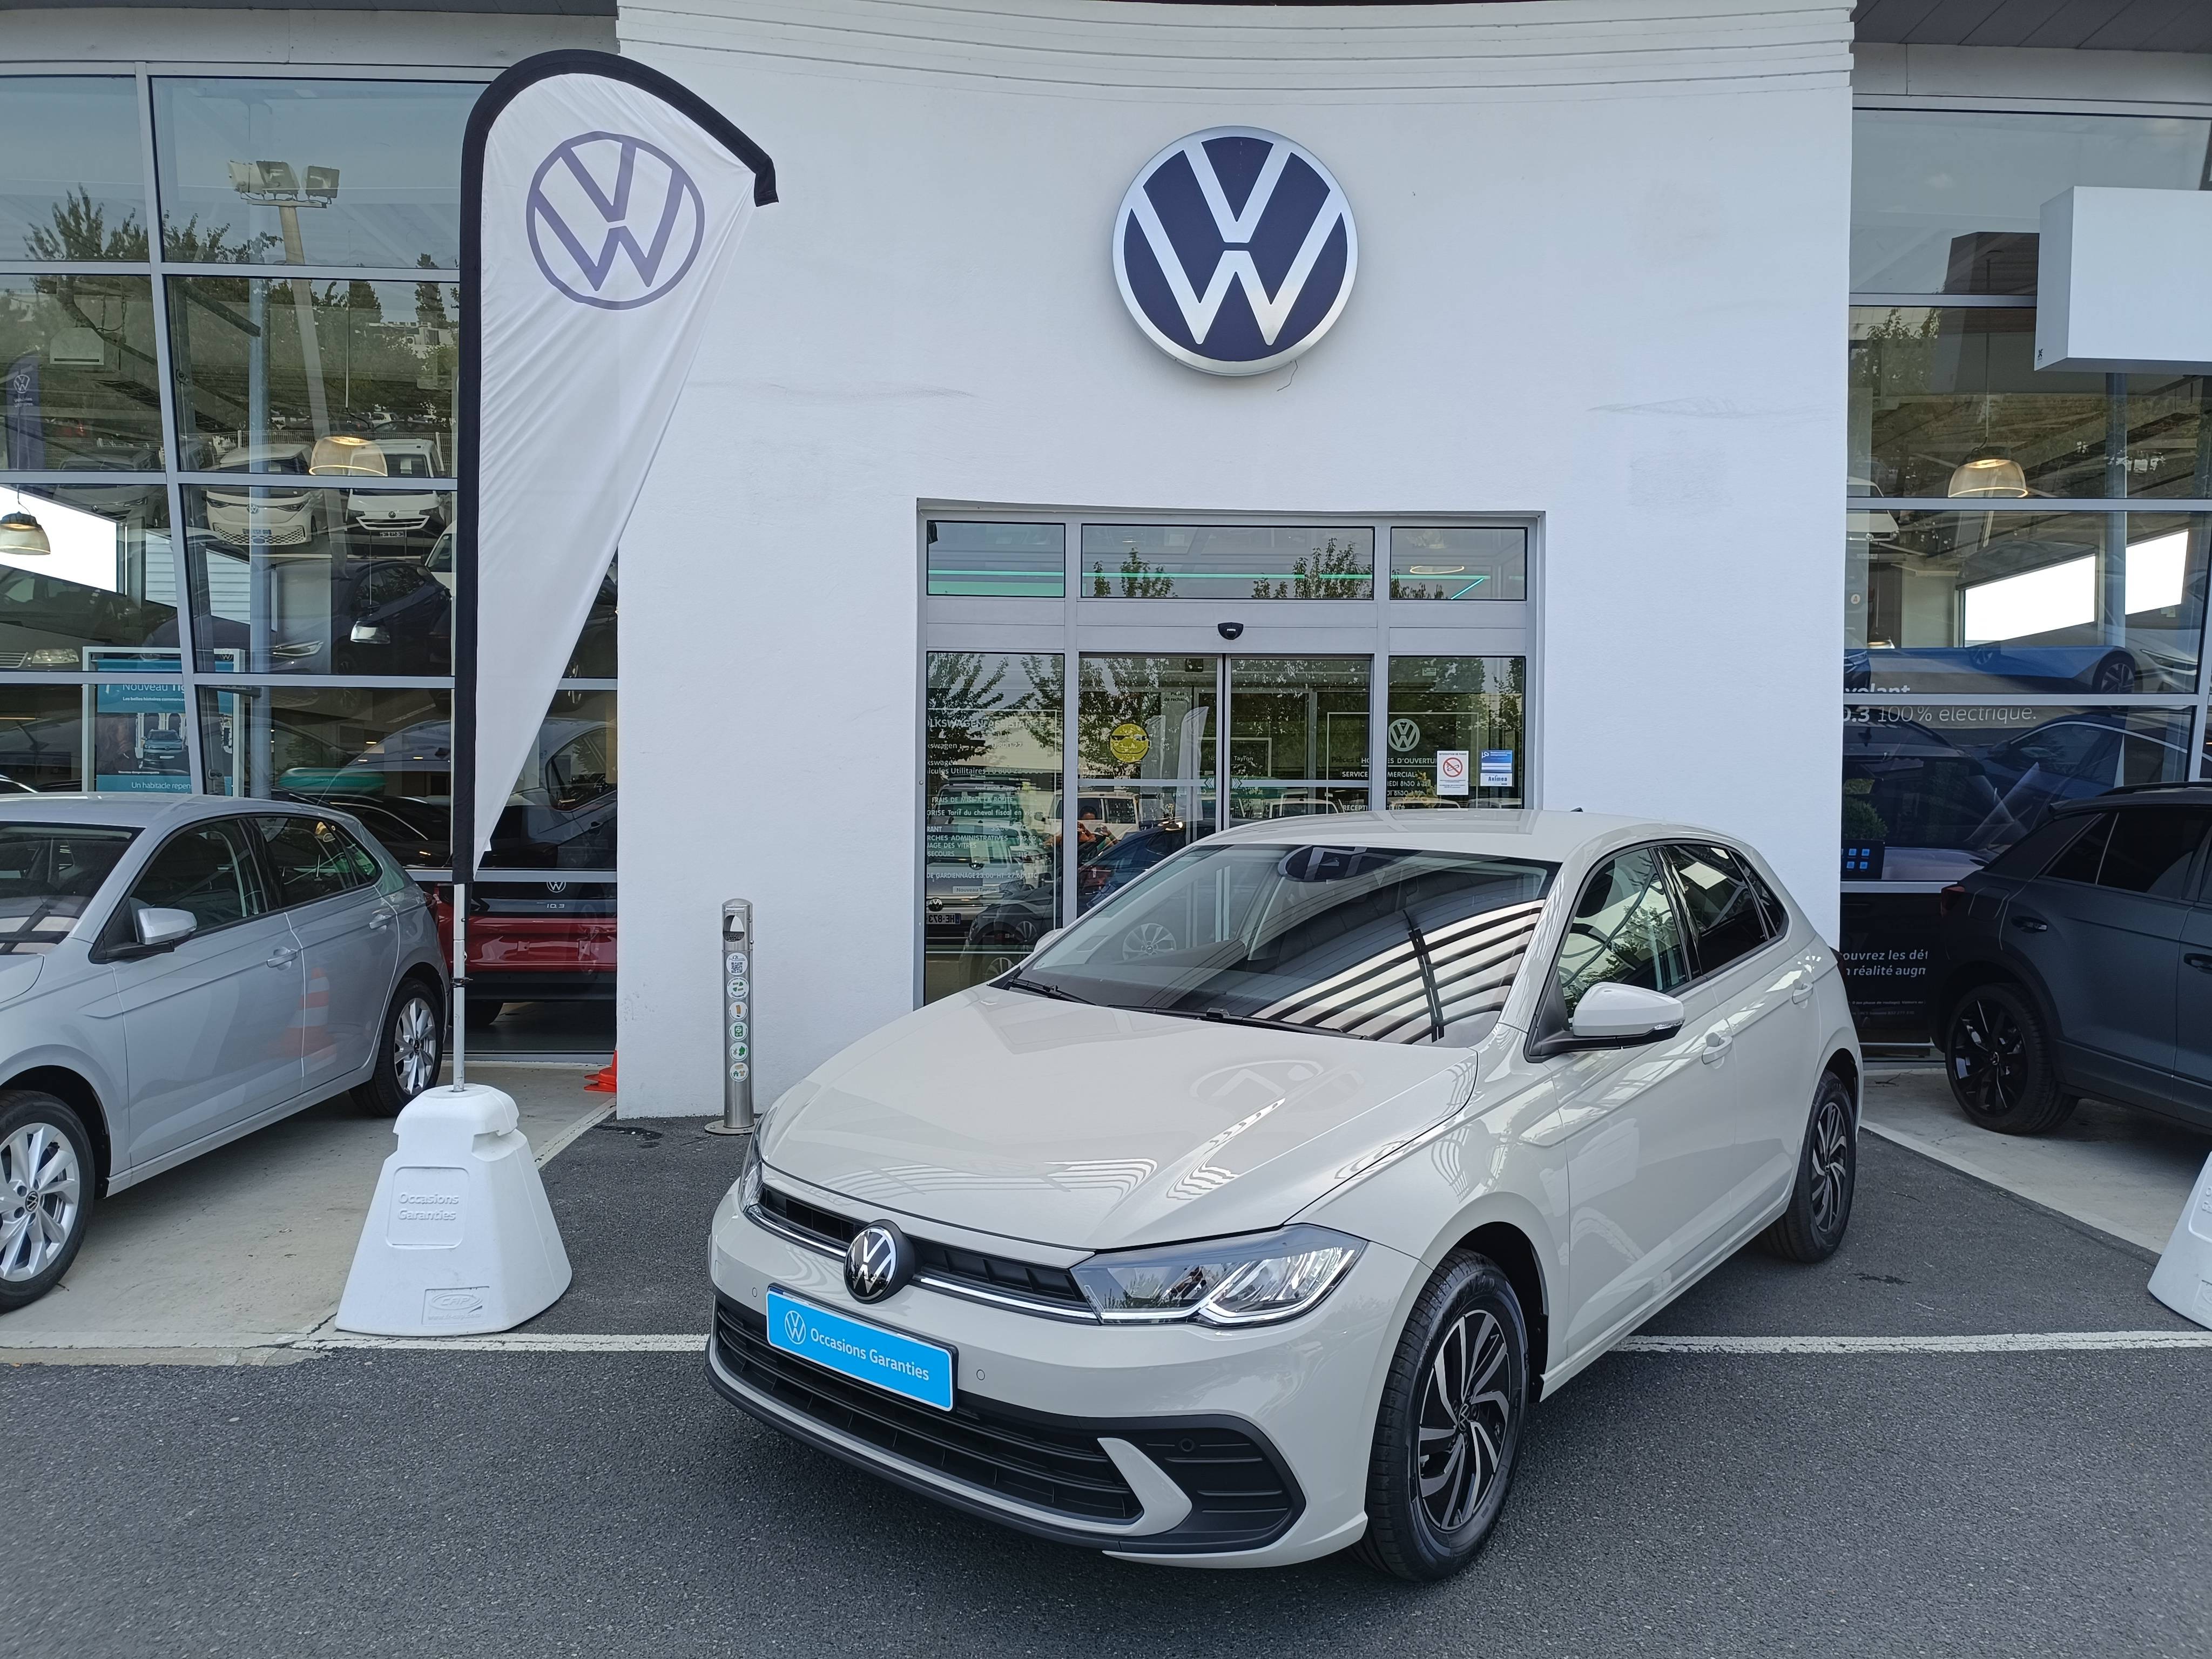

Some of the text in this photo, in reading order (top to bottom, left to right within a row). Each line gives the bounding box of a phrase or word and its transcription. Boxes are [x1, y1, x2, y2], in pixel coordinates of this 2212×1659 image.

[526, 131, 705, 311] VW
[1112, 126, 1358, 376] VW
[928, 719, 984, 728] LKSWAGEN
[1888, 949, 1906, 960] les
[1853, 965, 1893, 976] réalité
[399, 1192, 460, 1205] Occasions
[398, 1208, 457, 1220] Garanties
[785, 1310, 930, 1381] VW Occasions Garanties
